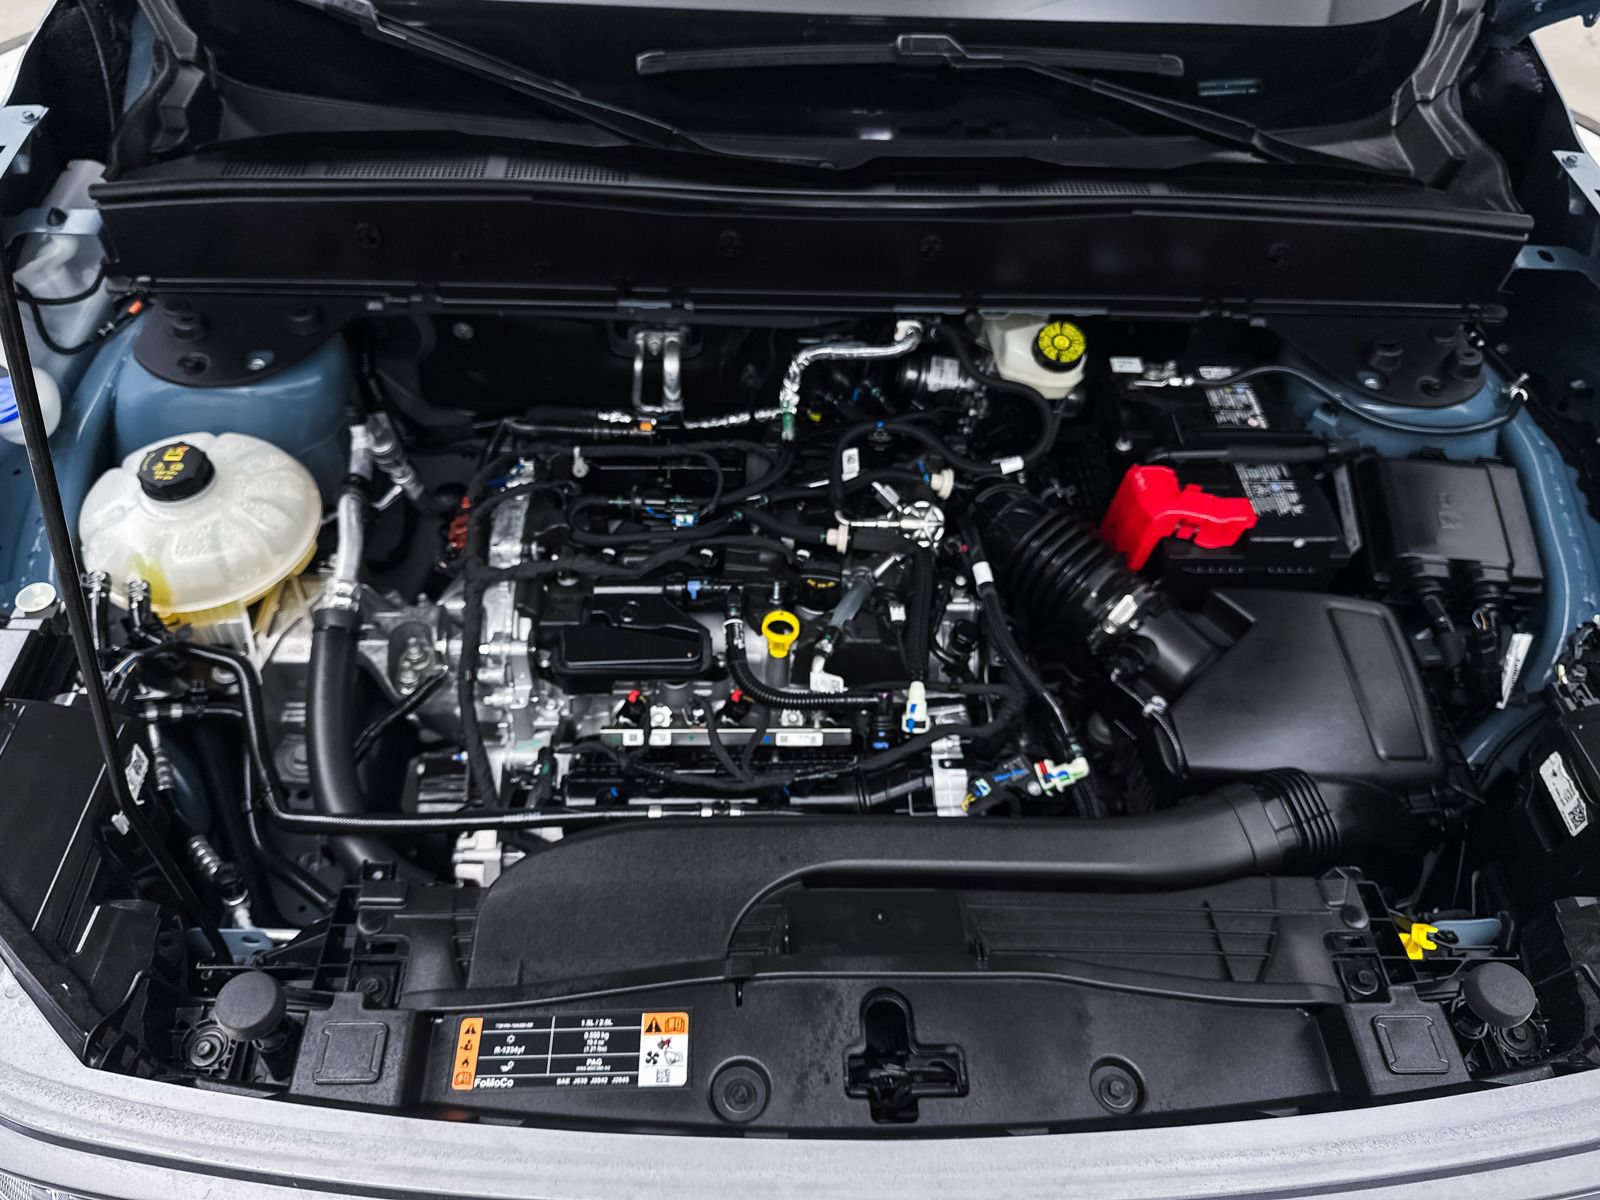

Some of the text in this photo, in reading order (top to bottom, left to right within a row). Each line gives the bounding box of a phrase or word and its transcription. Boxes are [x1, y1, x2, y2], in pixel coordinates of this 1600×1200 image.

[493, 1045, 526, 1055] R-1234yf
[586, 1058, 603, 1066] PAG
[474, 1077, 514, 1088] FoMoCo
[556, 1077, 571, 1085] SAE
[572, 1077, 588, 1085] J639
